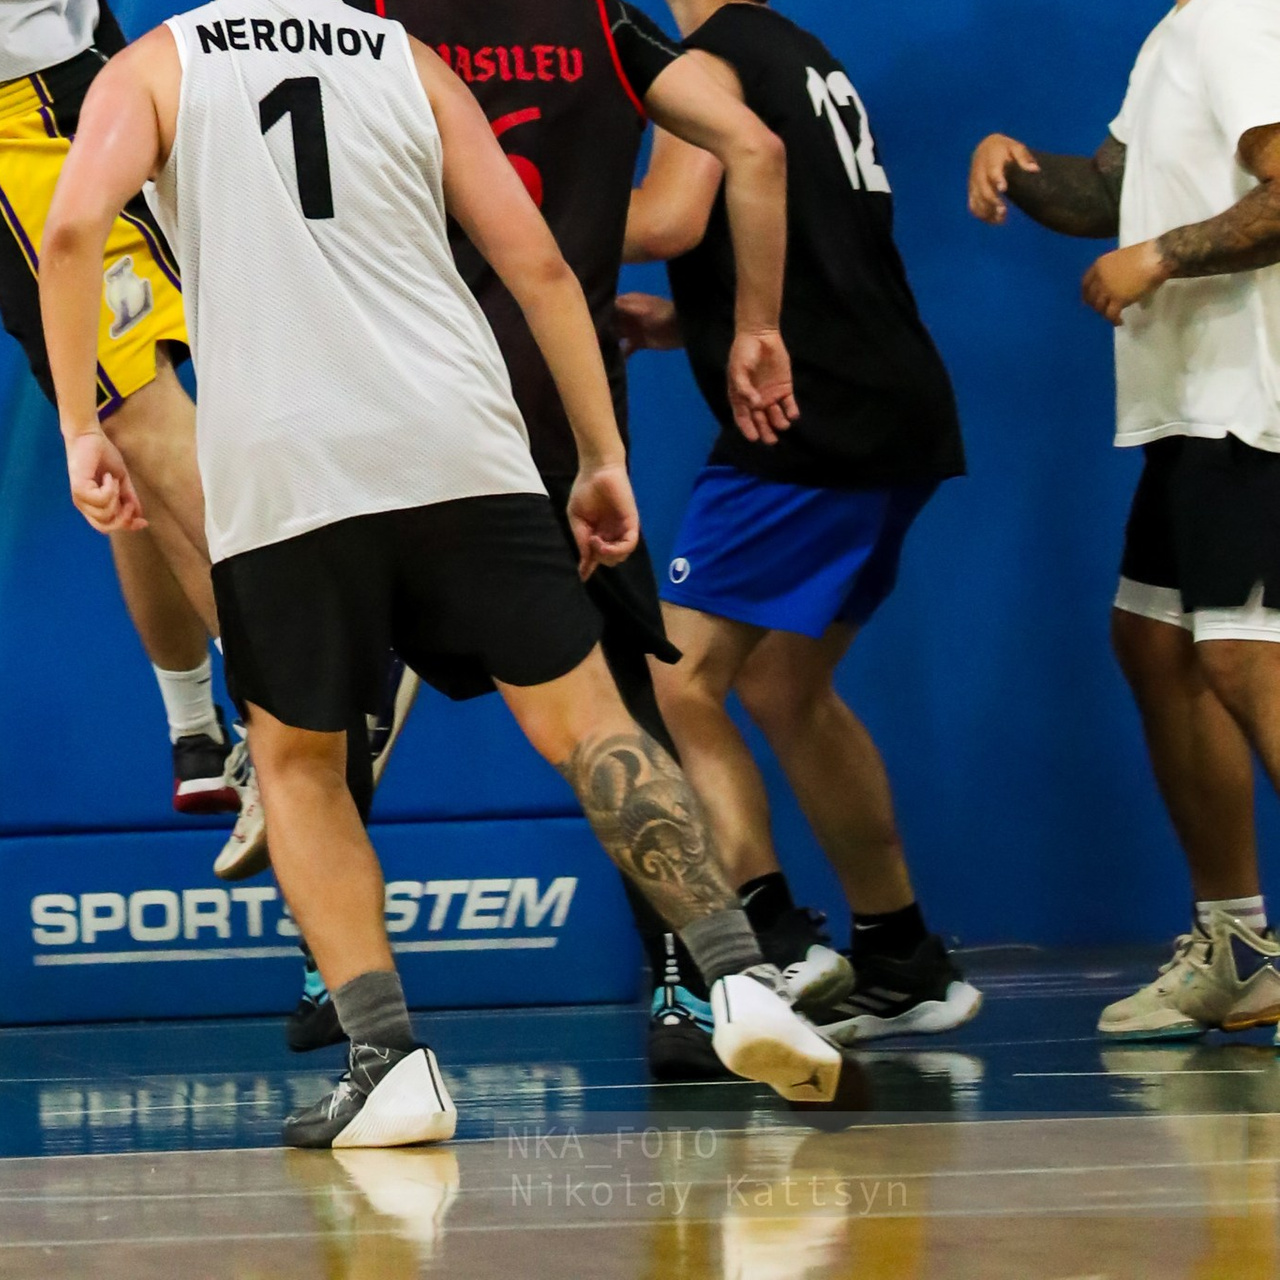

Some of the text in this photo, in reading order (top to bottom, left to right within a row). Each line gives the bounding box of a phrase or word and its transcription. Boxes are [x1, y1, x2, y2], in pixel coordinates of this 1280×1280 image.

[196, 17, 386, 61] NERONOV
[258, 76, 335, 220] 1
[805, 66, 893, 193] 12
[30, 876, 579, 945] SPORTSTEM
